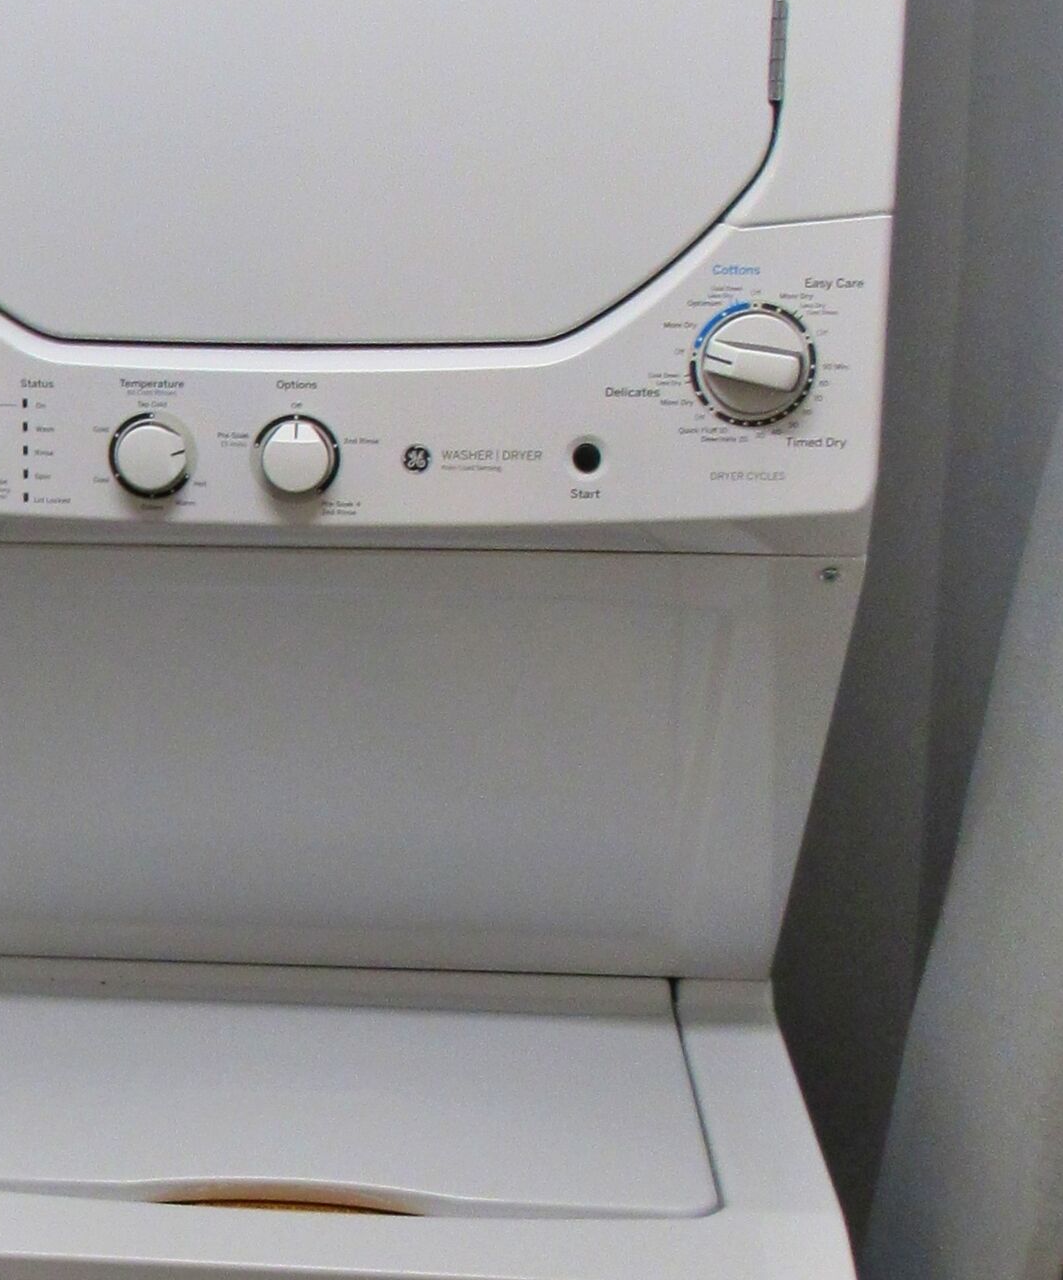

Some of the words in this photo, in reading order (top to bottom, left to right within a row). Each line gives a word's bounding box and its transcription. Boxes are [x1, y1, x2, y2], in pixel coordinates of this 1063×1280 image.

[712, 265, 761, 276] Cottons
[804, 277, 833, 291] Easy
[835, 277, 865, 289] Care
[20, 378, 55, 389] Status
[120, 378, 185, 390] Temperature
[276, 379, 318, 391] Options
[604, 386, 661, 398] Delicates
[786, 436, 823, 448] Timed
[825, 436, 847, 450] Dry
[442, 449, 494, 462] WASHER
[501, 449, 543, 462] DRYER
[710, 471, 744, 481] DRYER
[746, 471, 785, 481] CYCLES
[570, 487, 601, 499] Start
